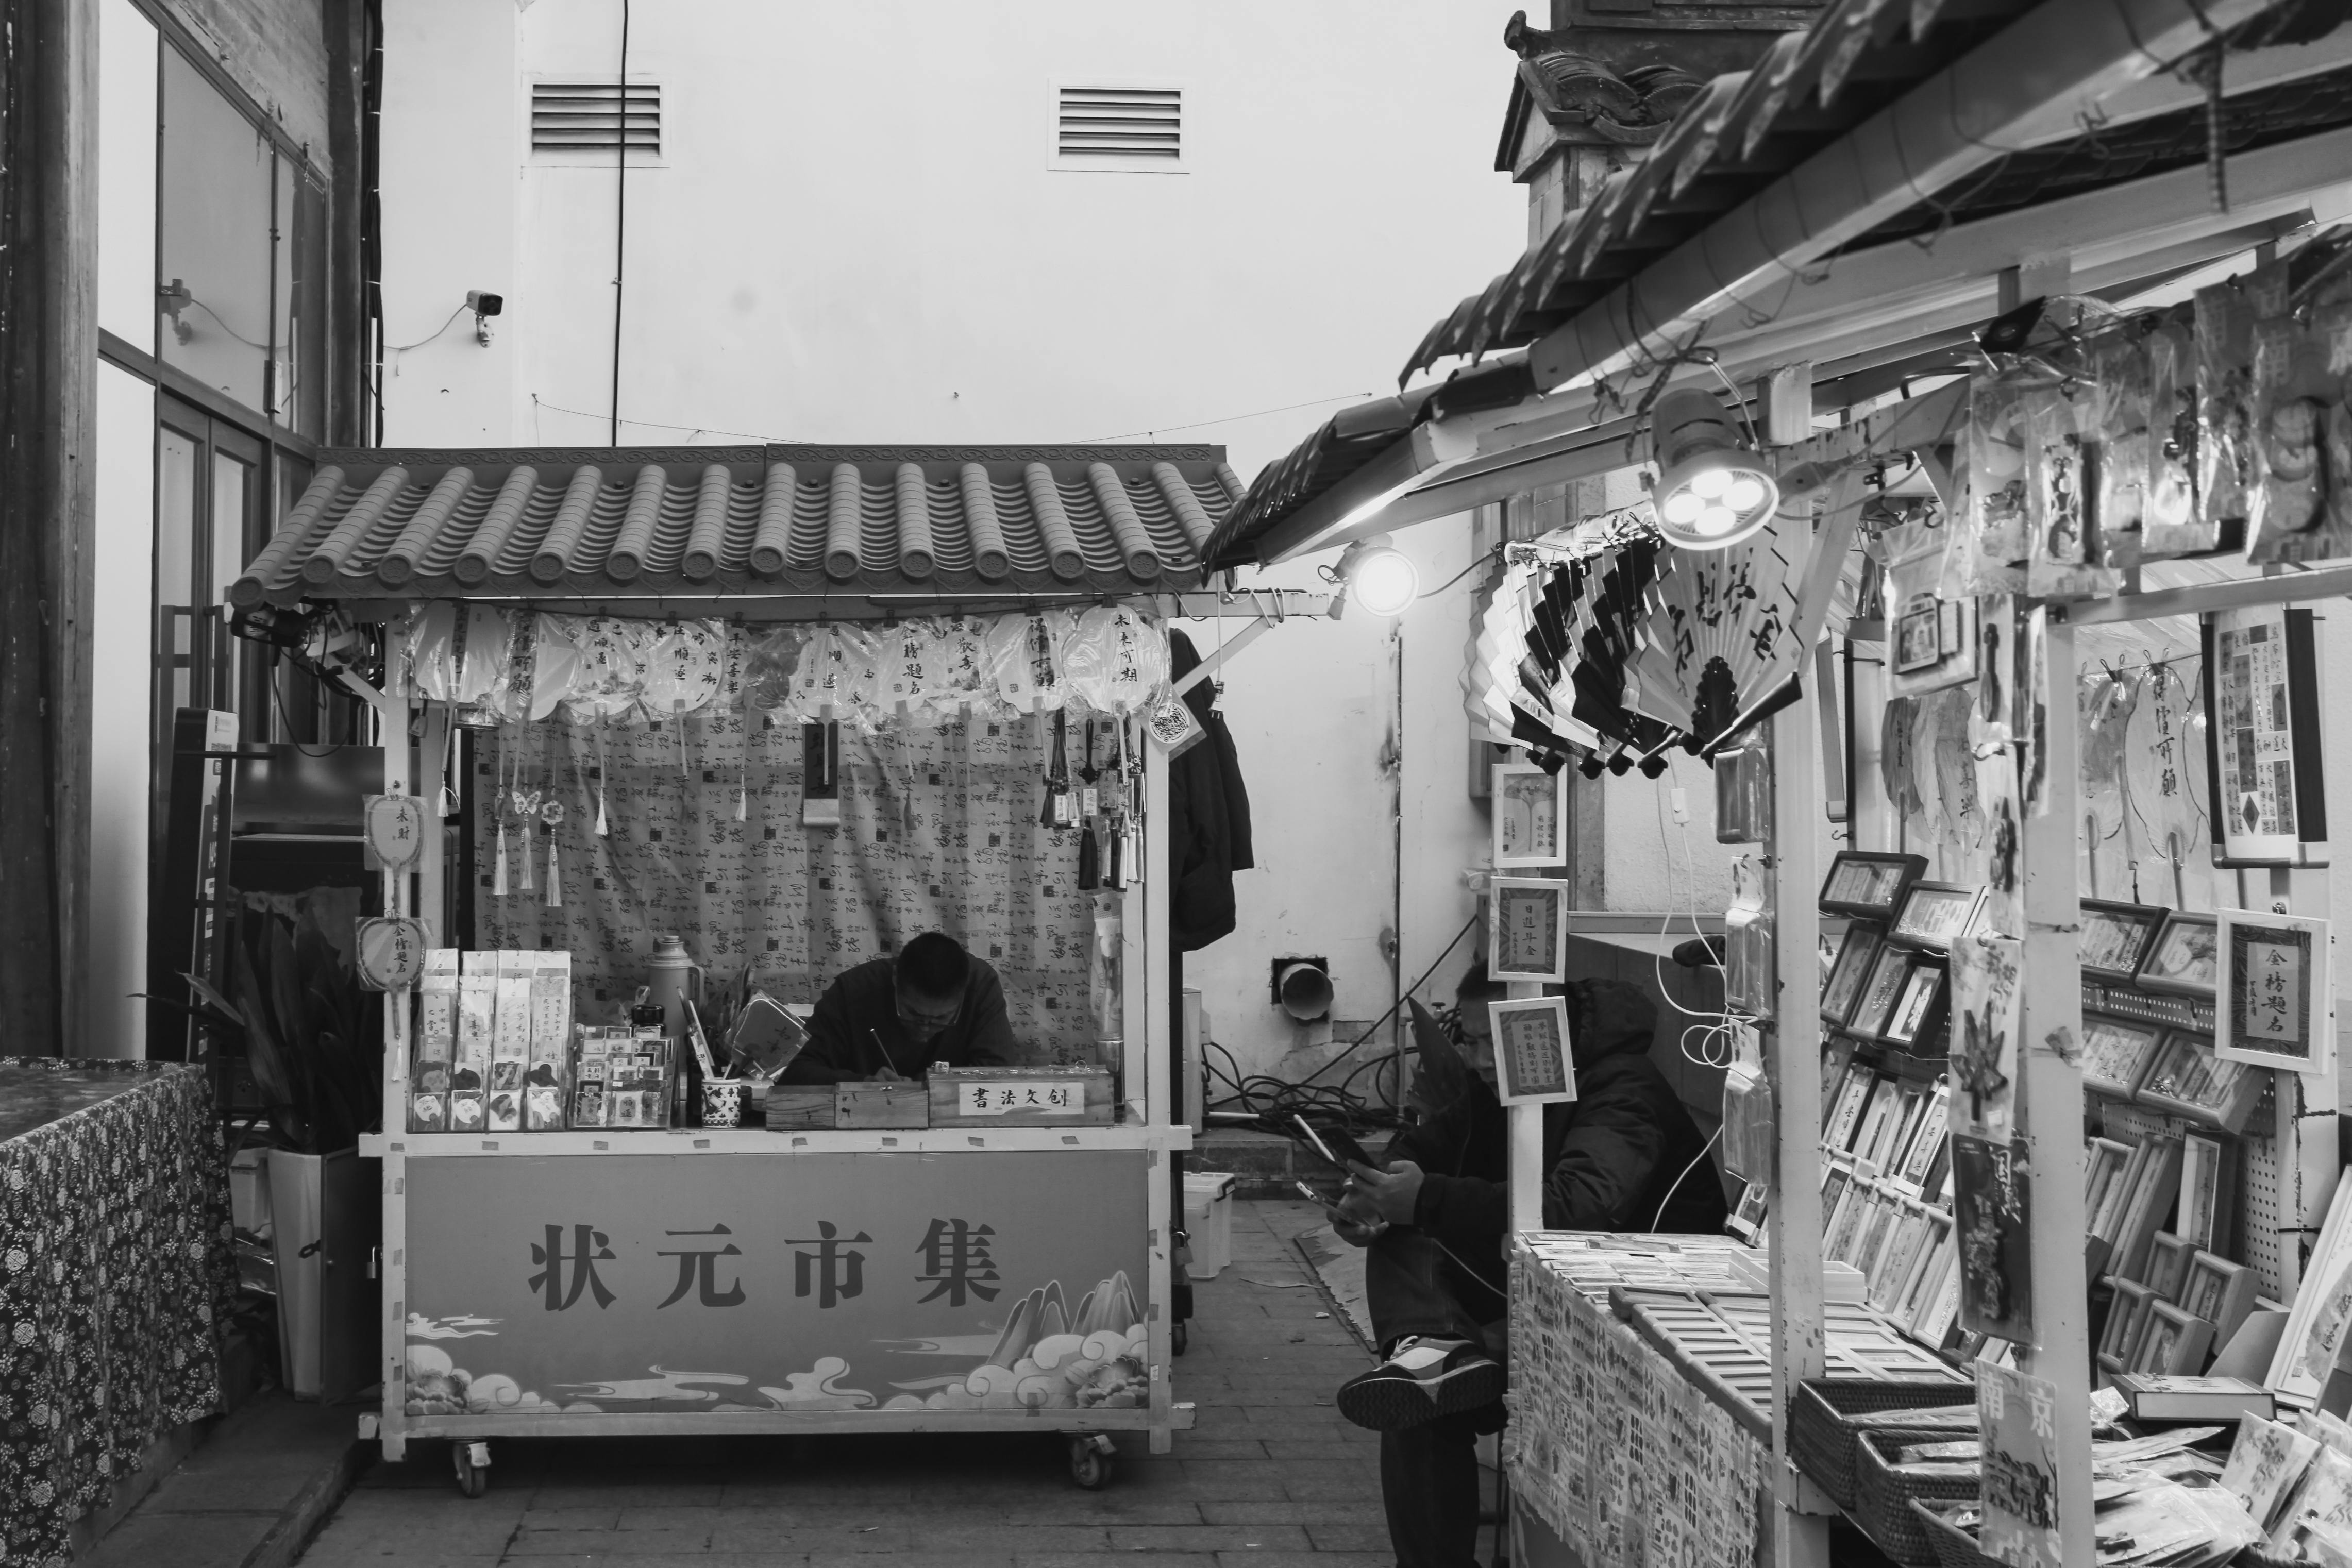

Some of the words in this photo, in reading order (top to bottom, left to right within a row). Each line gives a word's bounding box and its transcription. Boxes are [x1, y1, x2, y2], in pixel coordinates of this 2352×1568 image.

[2261, 948, 2288, 1032] 金榜題名
[528, 1218, 1001, 1312] 状元市集
[1979, 1371, 2054, 1439] 南京
